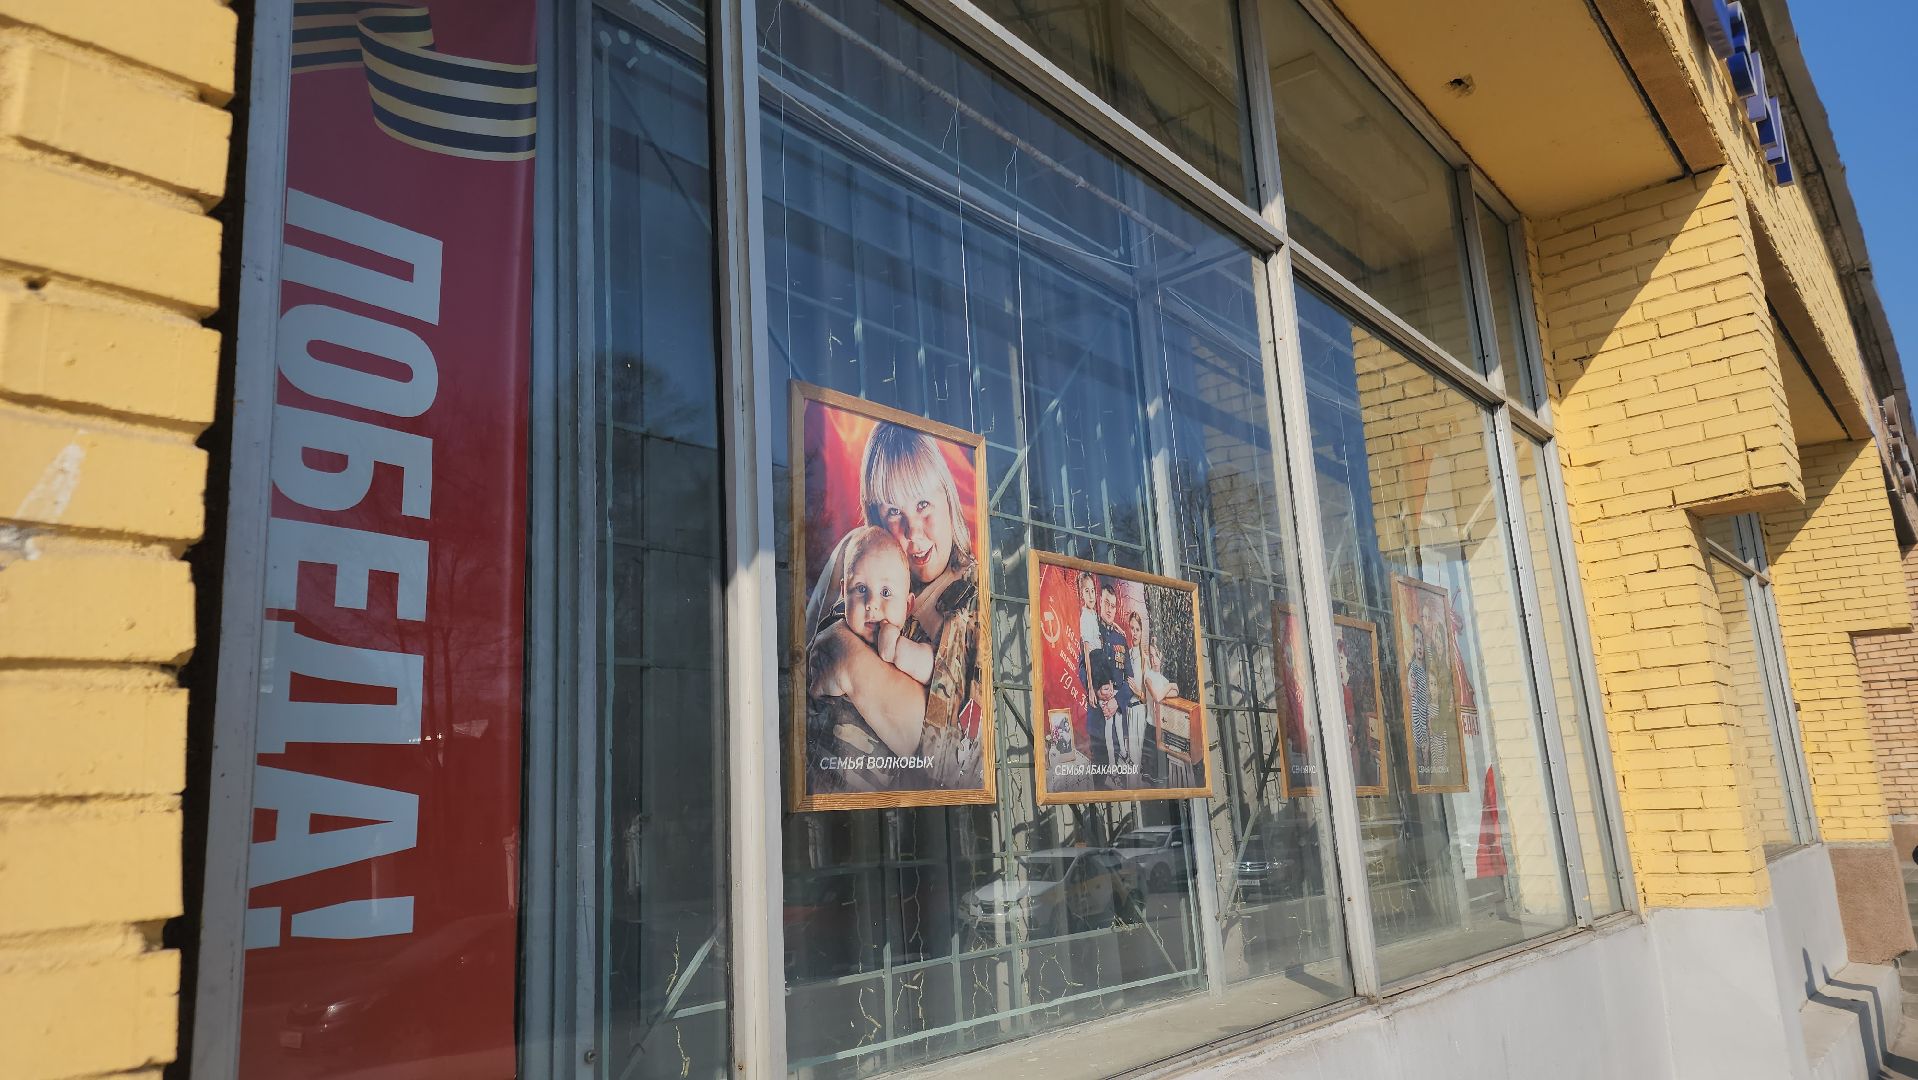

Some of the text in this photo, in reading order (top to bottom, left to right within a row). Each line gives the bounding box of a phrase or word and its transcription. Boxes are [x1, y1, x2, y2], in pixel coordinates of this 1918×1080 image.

[245, 187, 444, 950] ПОБЕДА!
[1060, 668, 1073, 690] 79
[819, 755, 935, 771] СЕМЬЯ ВОЛКОВЫХ
[1054, 764, 1084, 775] СЕМЬЯ
